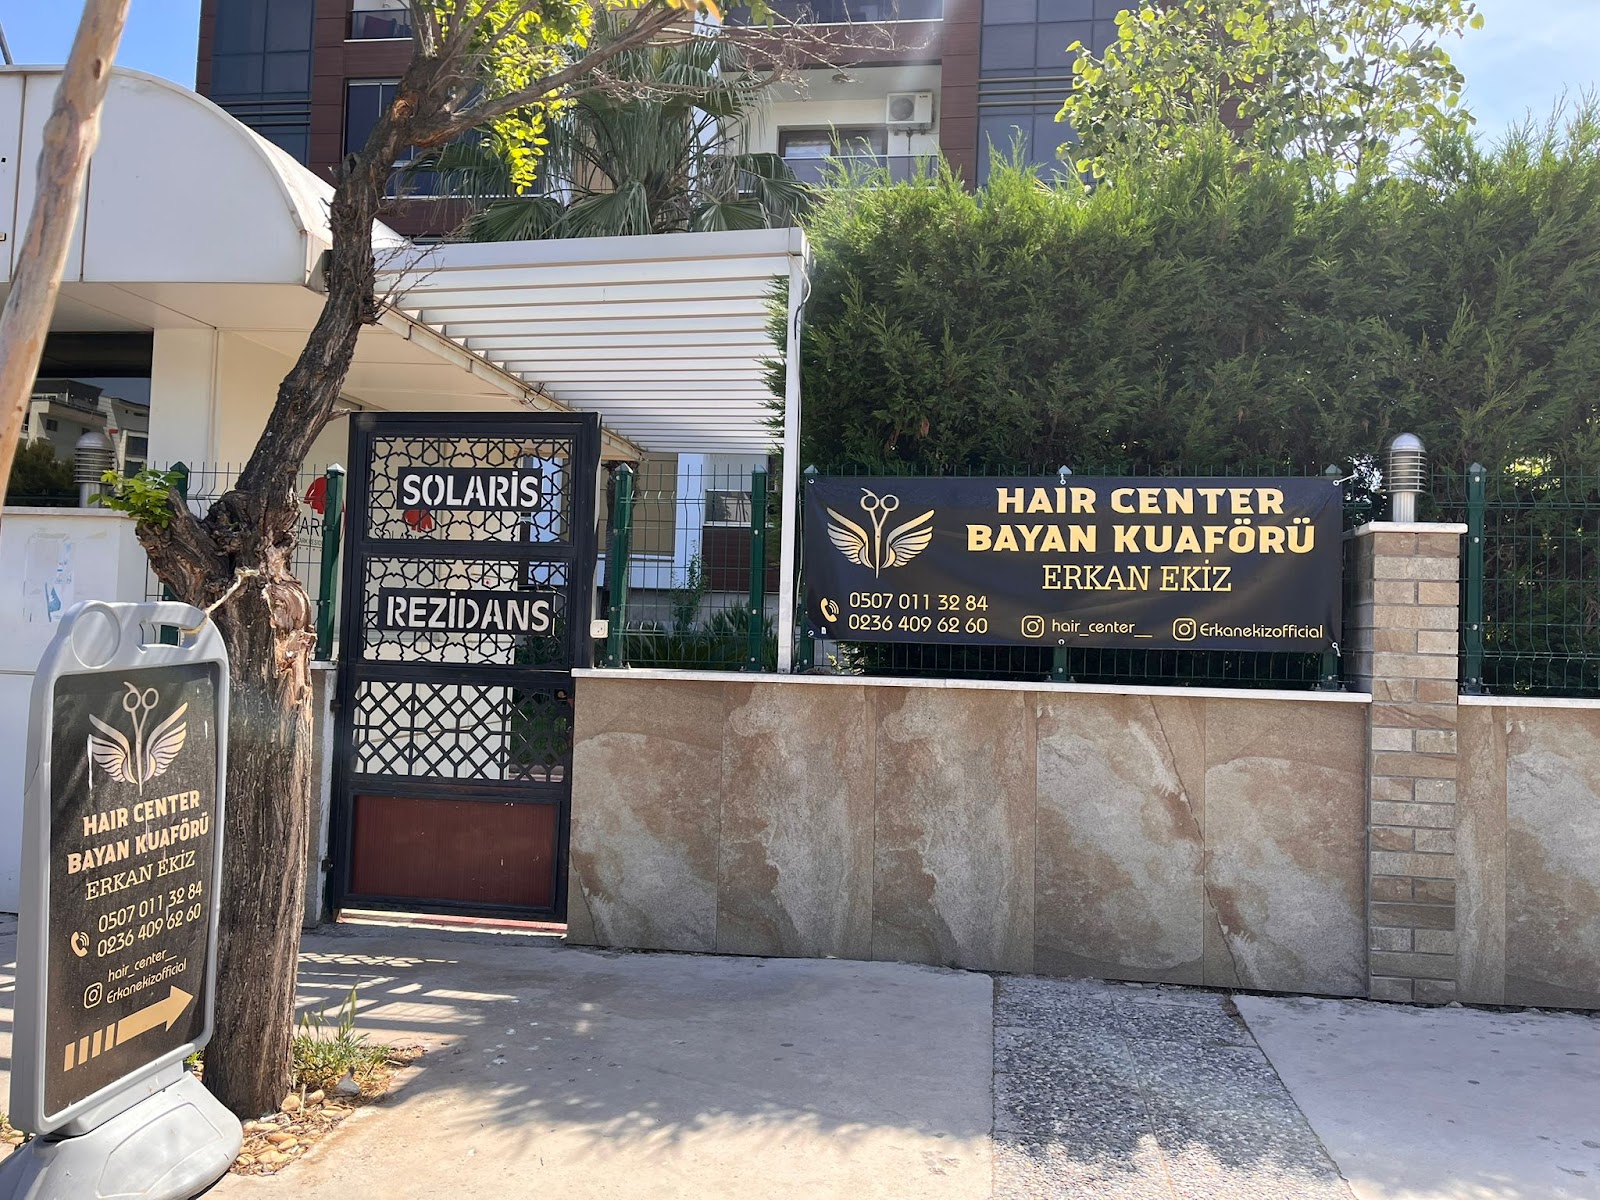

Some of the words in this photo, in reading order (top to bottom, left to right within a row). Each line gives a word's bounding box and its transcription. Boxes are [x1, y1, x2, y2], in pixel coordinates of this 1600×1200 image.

[402, 471, 539, 508] SOLARİS
[1110, 487, 1285, 515] CENTER
[965, 523, 1097, 553] BAYAN
[1112, 517, 1316, 554] KUAFÖRÜ
[1042, 564, 1152, 591] ERKAN
[1159, 559, 1233, 592] EKİZ
[385, 591, 550, 632] REZİDANS
[849, 591, 894, 609] 0507
[898, 593, 930, 610] 011
[937, 594, 960, 611] 32
[965, 595, 989, 612] 84
[848, 614, 893, 632] 0236
[897, 615, 932, 633] 409
[936, 616, 960, 634] 62
[964, 617, 989, 635] 60
[82, 807, 129, 837] HAIR
[133, 789, 200, 823] CENTER
[67, 839, 130, 875] BAYAN
[135, 811, 209, 855] KUAFÖRÜ
[85, 863, 153, 901] ERKAN
[156, 849, 196, 878] EKİZ
[98, 904, 136, 933] 0507
[139, 894, 163, 918] 011
[168, 887, 185, 908] 32
[187, 880, 203, 900] 84
[97, 929, 135, 957] 0236
[138, 917, 164, 941] 409
[166, 909, 184, 930] 62
[186, 902, 201, 922] 60
